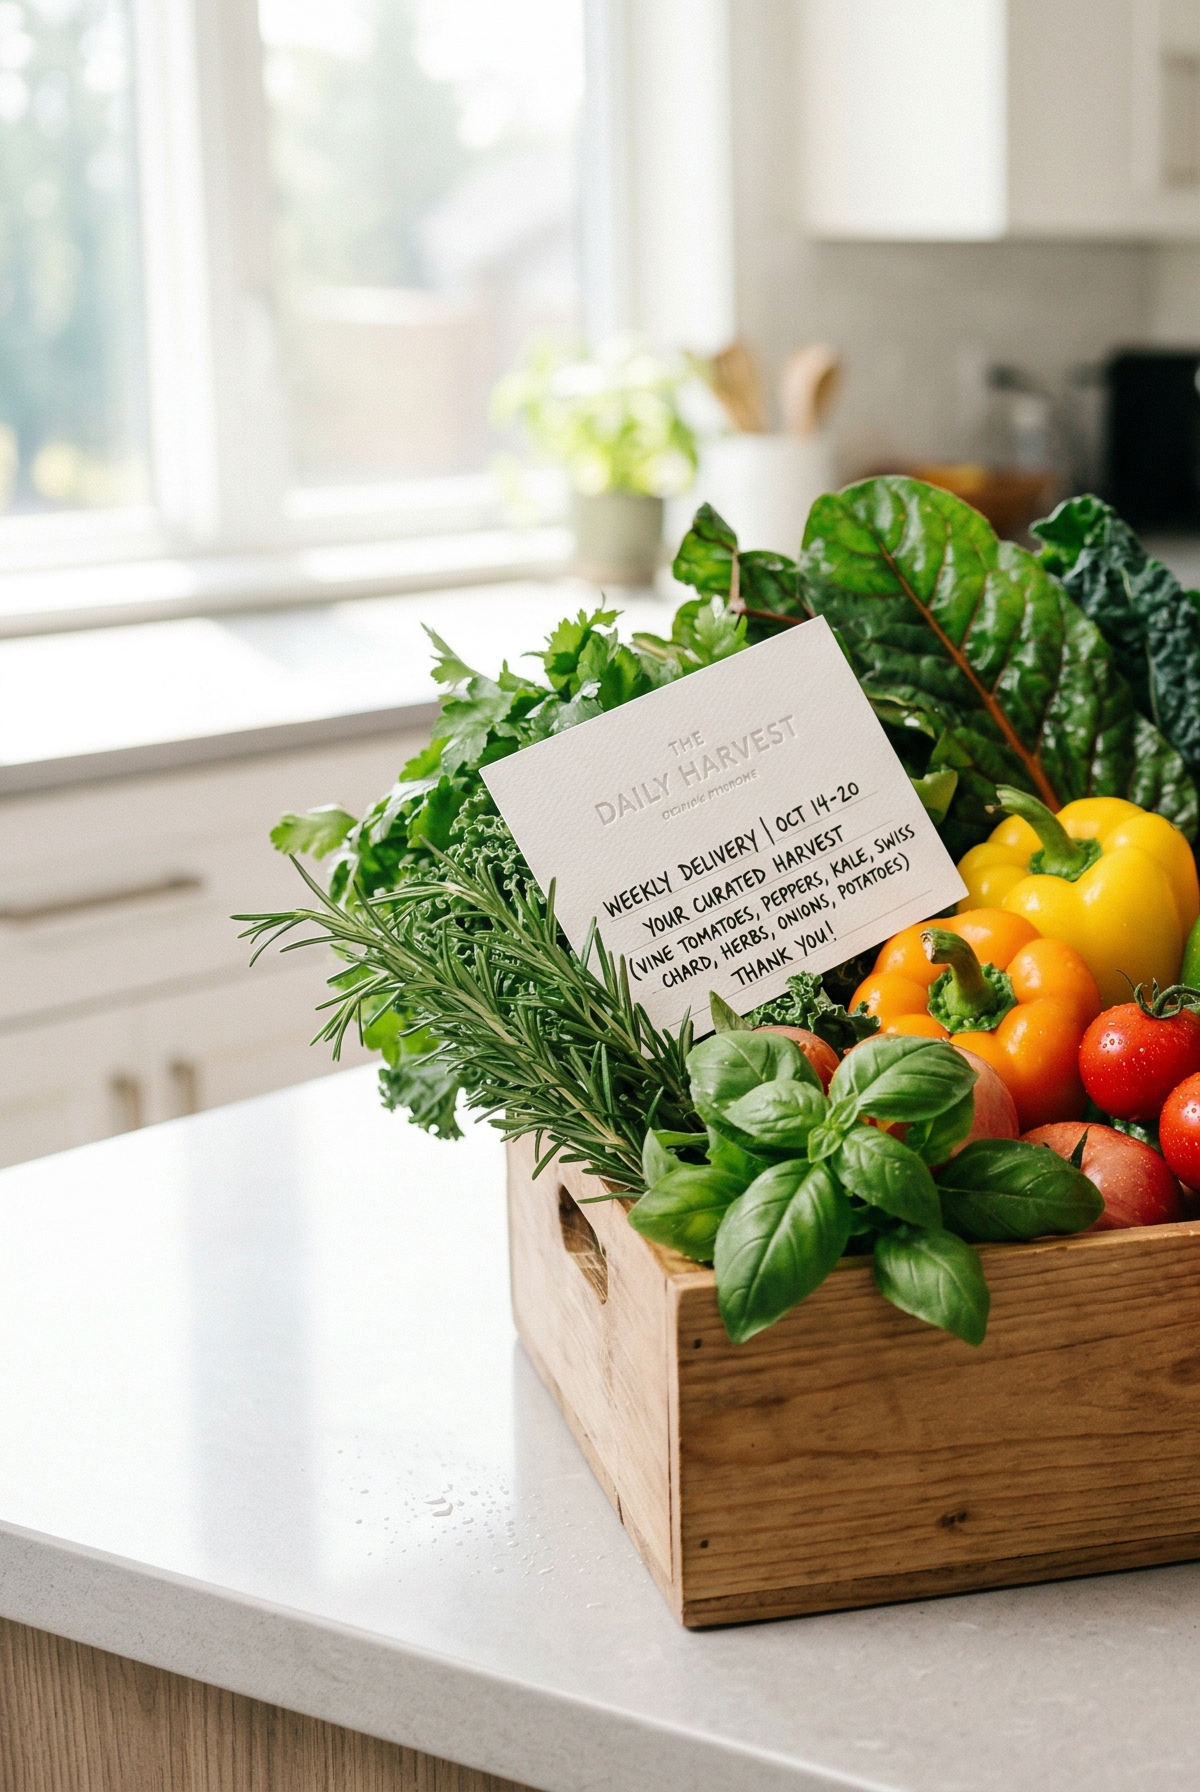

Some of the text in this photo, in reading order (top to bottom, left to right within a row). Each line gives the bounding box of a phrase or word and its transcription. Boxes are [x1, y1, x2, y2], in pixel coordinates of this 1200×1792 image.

[594, 773, 671, 826] DAILY
[678, 714, 798, 787] HARVEST
[668, 730, 705, 756] THE
[602, 872, 672, 918] WEEKLY
[677, 828, 759, 881] DELIVERY
[775, 805, 806, 833] OCT
[810, 782, 859, 816] 14-20
[628, 823, 915, 982] (VINE TOMATOES, PEPPERS, KALE, SWISS
[641, 824, 844, 938] YOUR CURATED HARVEST
[662, 852, 910, 988] CHARD, HERBS, ONIONS, POTATOES)
[730, 920, 837, 986] THANK YOU!
